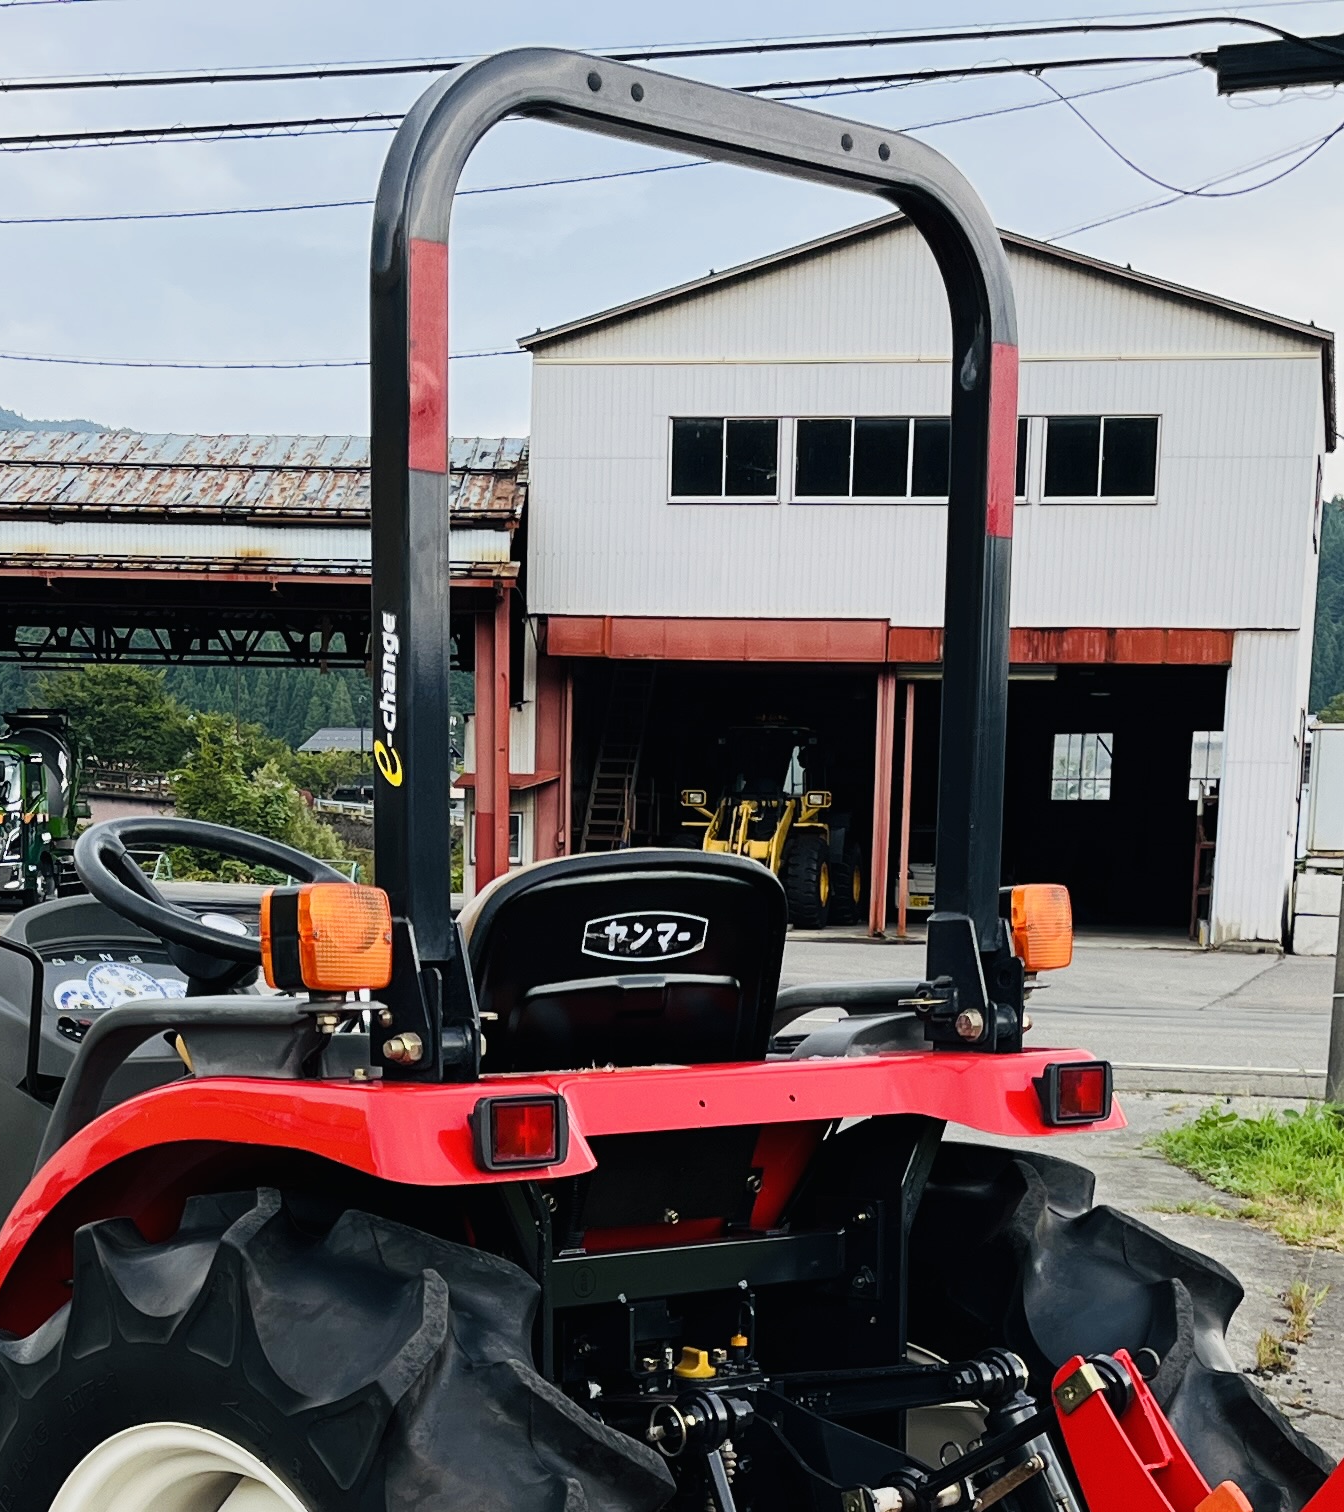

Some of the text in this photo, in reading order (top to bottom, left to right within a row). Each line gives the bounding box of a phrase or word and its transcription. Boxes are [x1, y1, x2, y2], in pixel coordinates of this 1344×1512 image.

[373, 610, 404, 787] e-change
[604, 920, 692, 953] ヤンマー
